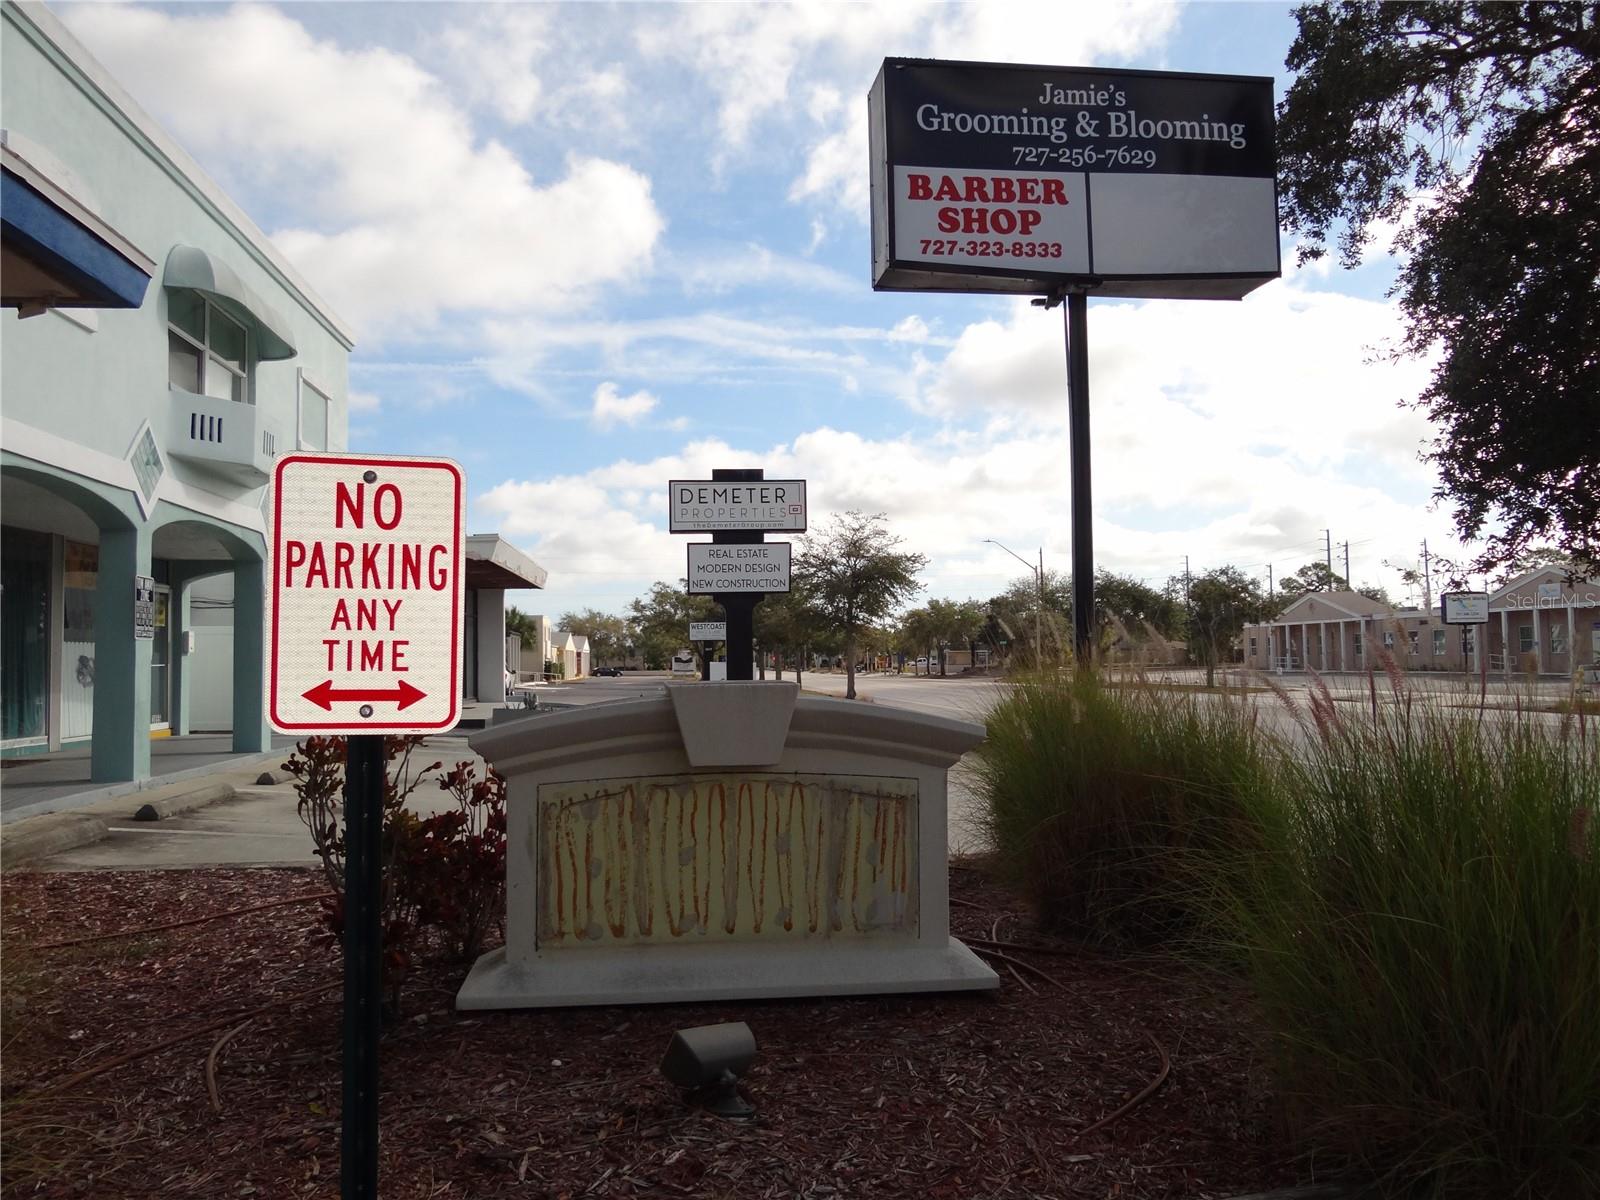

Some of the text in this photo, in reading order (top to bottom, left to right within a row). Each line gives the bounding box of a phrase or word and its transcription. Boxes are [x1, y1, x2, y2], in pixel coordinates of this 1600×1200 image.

[1038, 83, 1126, 107] Jamie's
[916, 103, 1247, 149] Grooming & Blooming
[1012, 145, 1156, 168] 727-256-7629
[907, 173, 1069, 206] BARBER
[938, 207, 1042, 236] SHOP
[919, 239, 1063, 259] 727-323-8333
[335, 481, 403, 531] NO
[680, 487, 786, 505] DEMETER
[681, 507, 787, 519] PROPERTIES
[285, 540, 448, 591] PARKING
[708, 549, 769, 559] REAL ESTATE
[697, 563, 781, 573] MODERN DESIGN
[692, 579, 786, 589] NEW CONSTRUCTION
[330, 598, 403, 631] ANY
[322, 640, 409, 672] TIME
